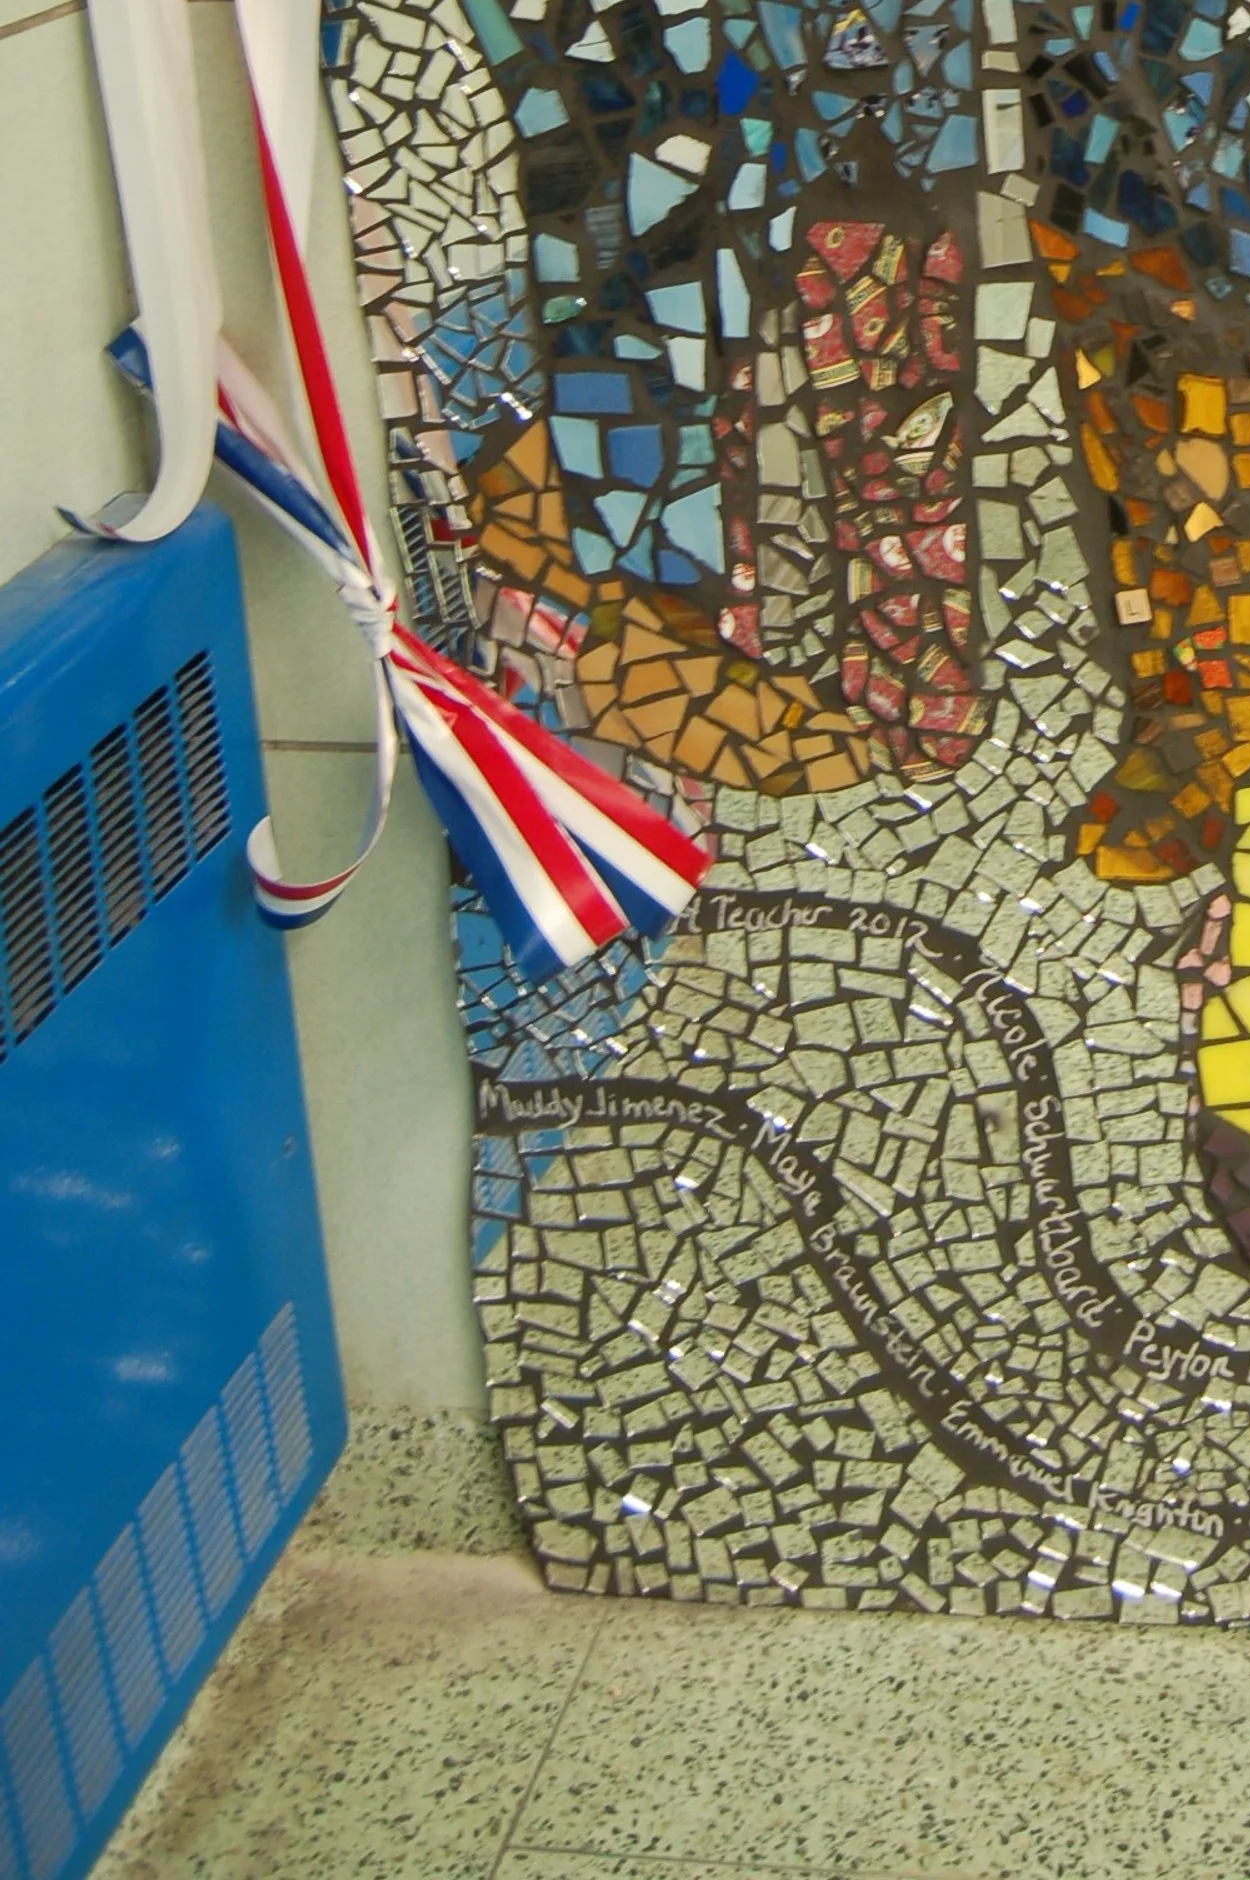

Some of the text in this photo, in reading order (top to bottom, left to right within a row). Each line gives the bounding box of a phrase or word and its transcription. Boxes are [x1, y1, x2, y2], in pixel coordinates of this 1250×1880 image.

[709, 894, 834, 932] Teacher
[849, 907, 943, 958] 2012
[960, 966, 1048, 1081] Nicole
[585, 1086, 737, 1139] Jimenez
[751, 1121, 822, 1217] Maya
[1123, 1318, 1234, 1381] Peyton
